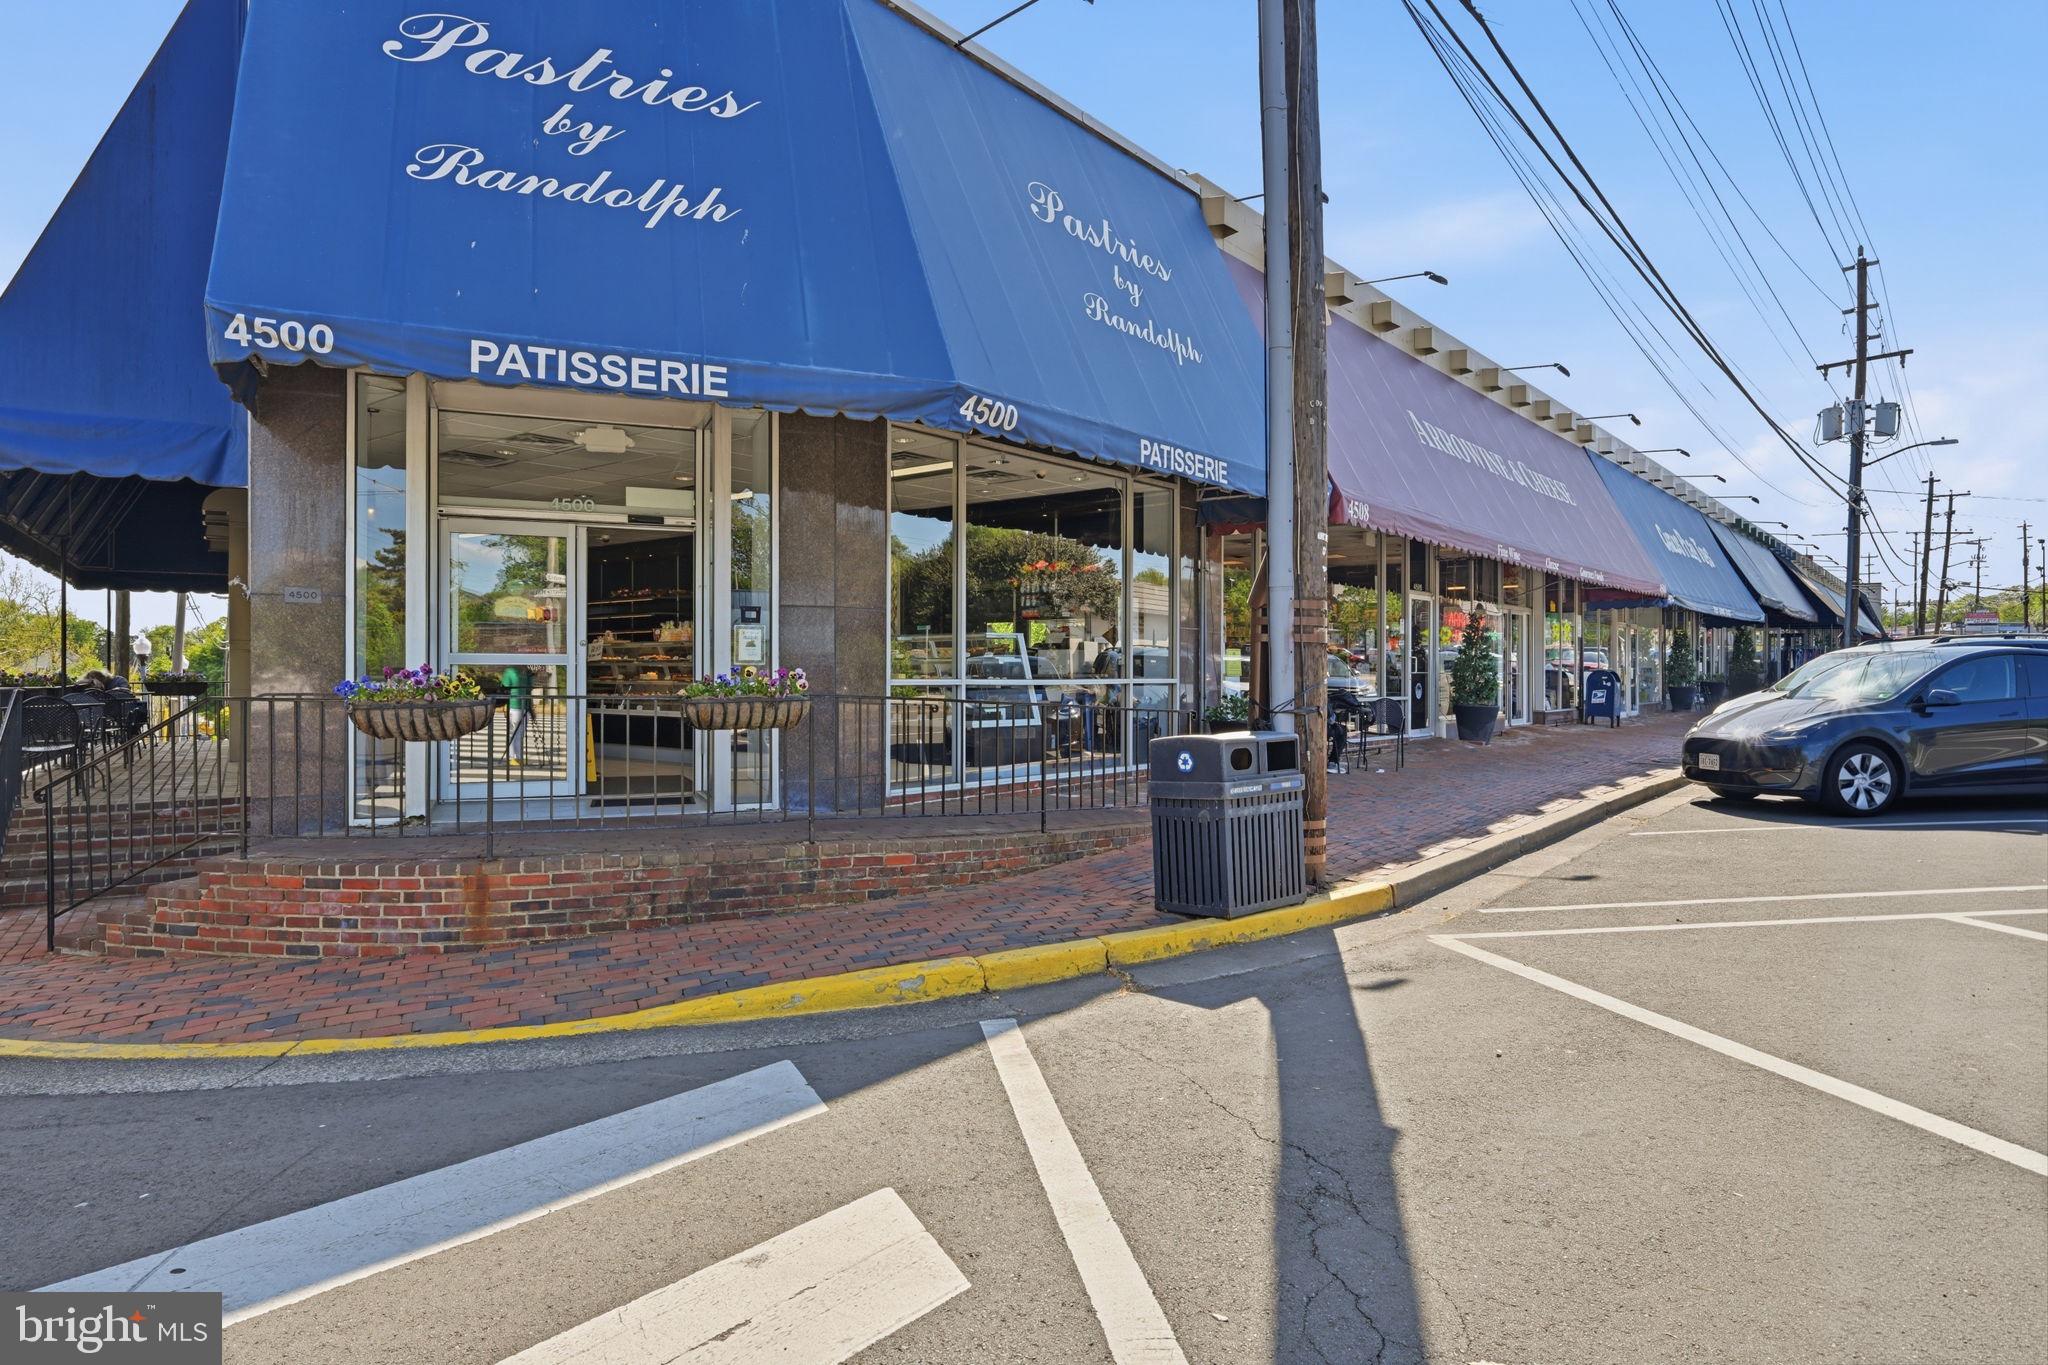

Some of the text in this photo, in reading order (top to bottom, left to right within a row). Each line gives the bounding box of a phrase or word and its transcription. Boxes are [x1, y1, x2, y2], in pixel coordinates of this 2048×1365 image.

[382, 14, 762, 118] Pastries
[543, 104, 626, 156] by
[406, 144, 742, 229] Randolph
[1028, 182, 1172, 281] Pastries
[1113, 265, 1143, 306] by
[224, 314, 334, 354] 4500
[1083, 292, 1203, 365] Randolph
[470, 340, 729, 397] PATISSERIE
[959, 395, 1018, 431] 4500
[1140, 438, 1228, 485] PATISSERIE
[1406, 408, 1514, 482] ARROWINE
[1516, 460, 1577, 507] CHEESE
[550, 497, 595, 512] 4500
[1348, 499, 1370, 522] 4508
[288, 590, 318, 600] 4500
